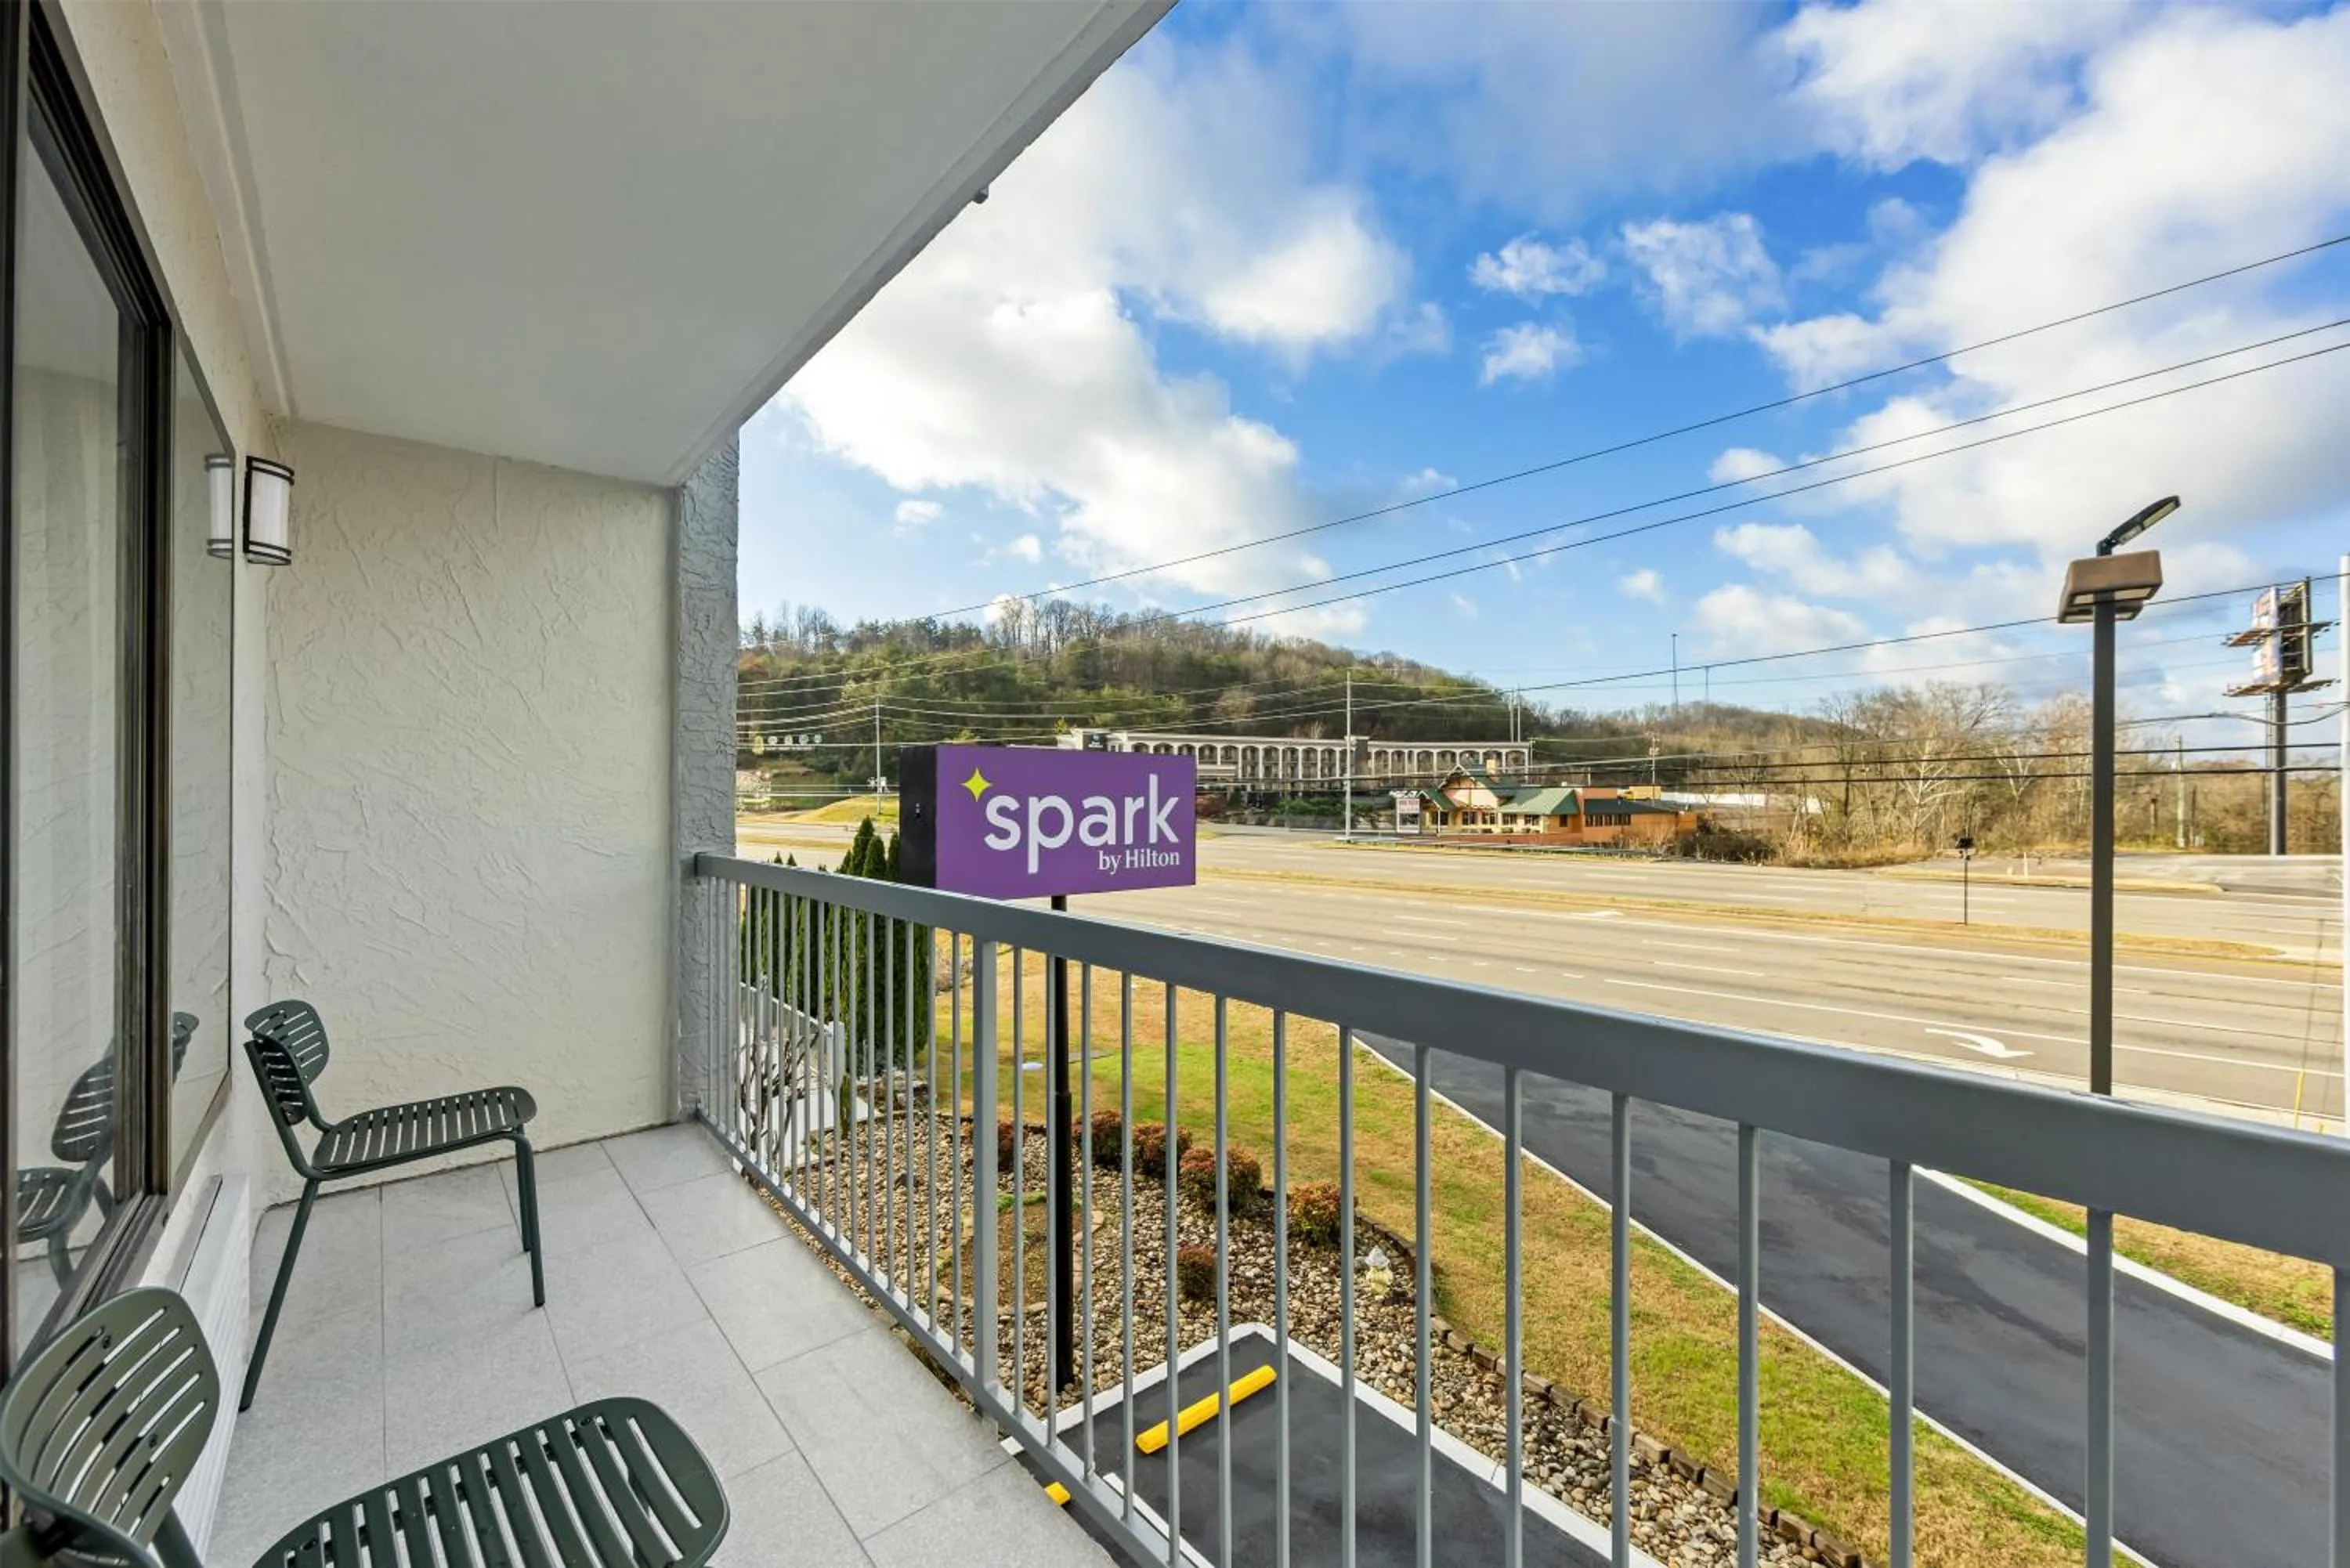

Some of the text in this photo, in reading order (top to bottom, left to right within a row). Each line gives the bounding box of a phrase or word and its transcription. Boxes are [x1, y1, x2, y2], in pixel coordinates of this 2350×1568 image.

[984, 774, 1180, 875] spark
[1098, 848, 1180, 876] by Hilton
